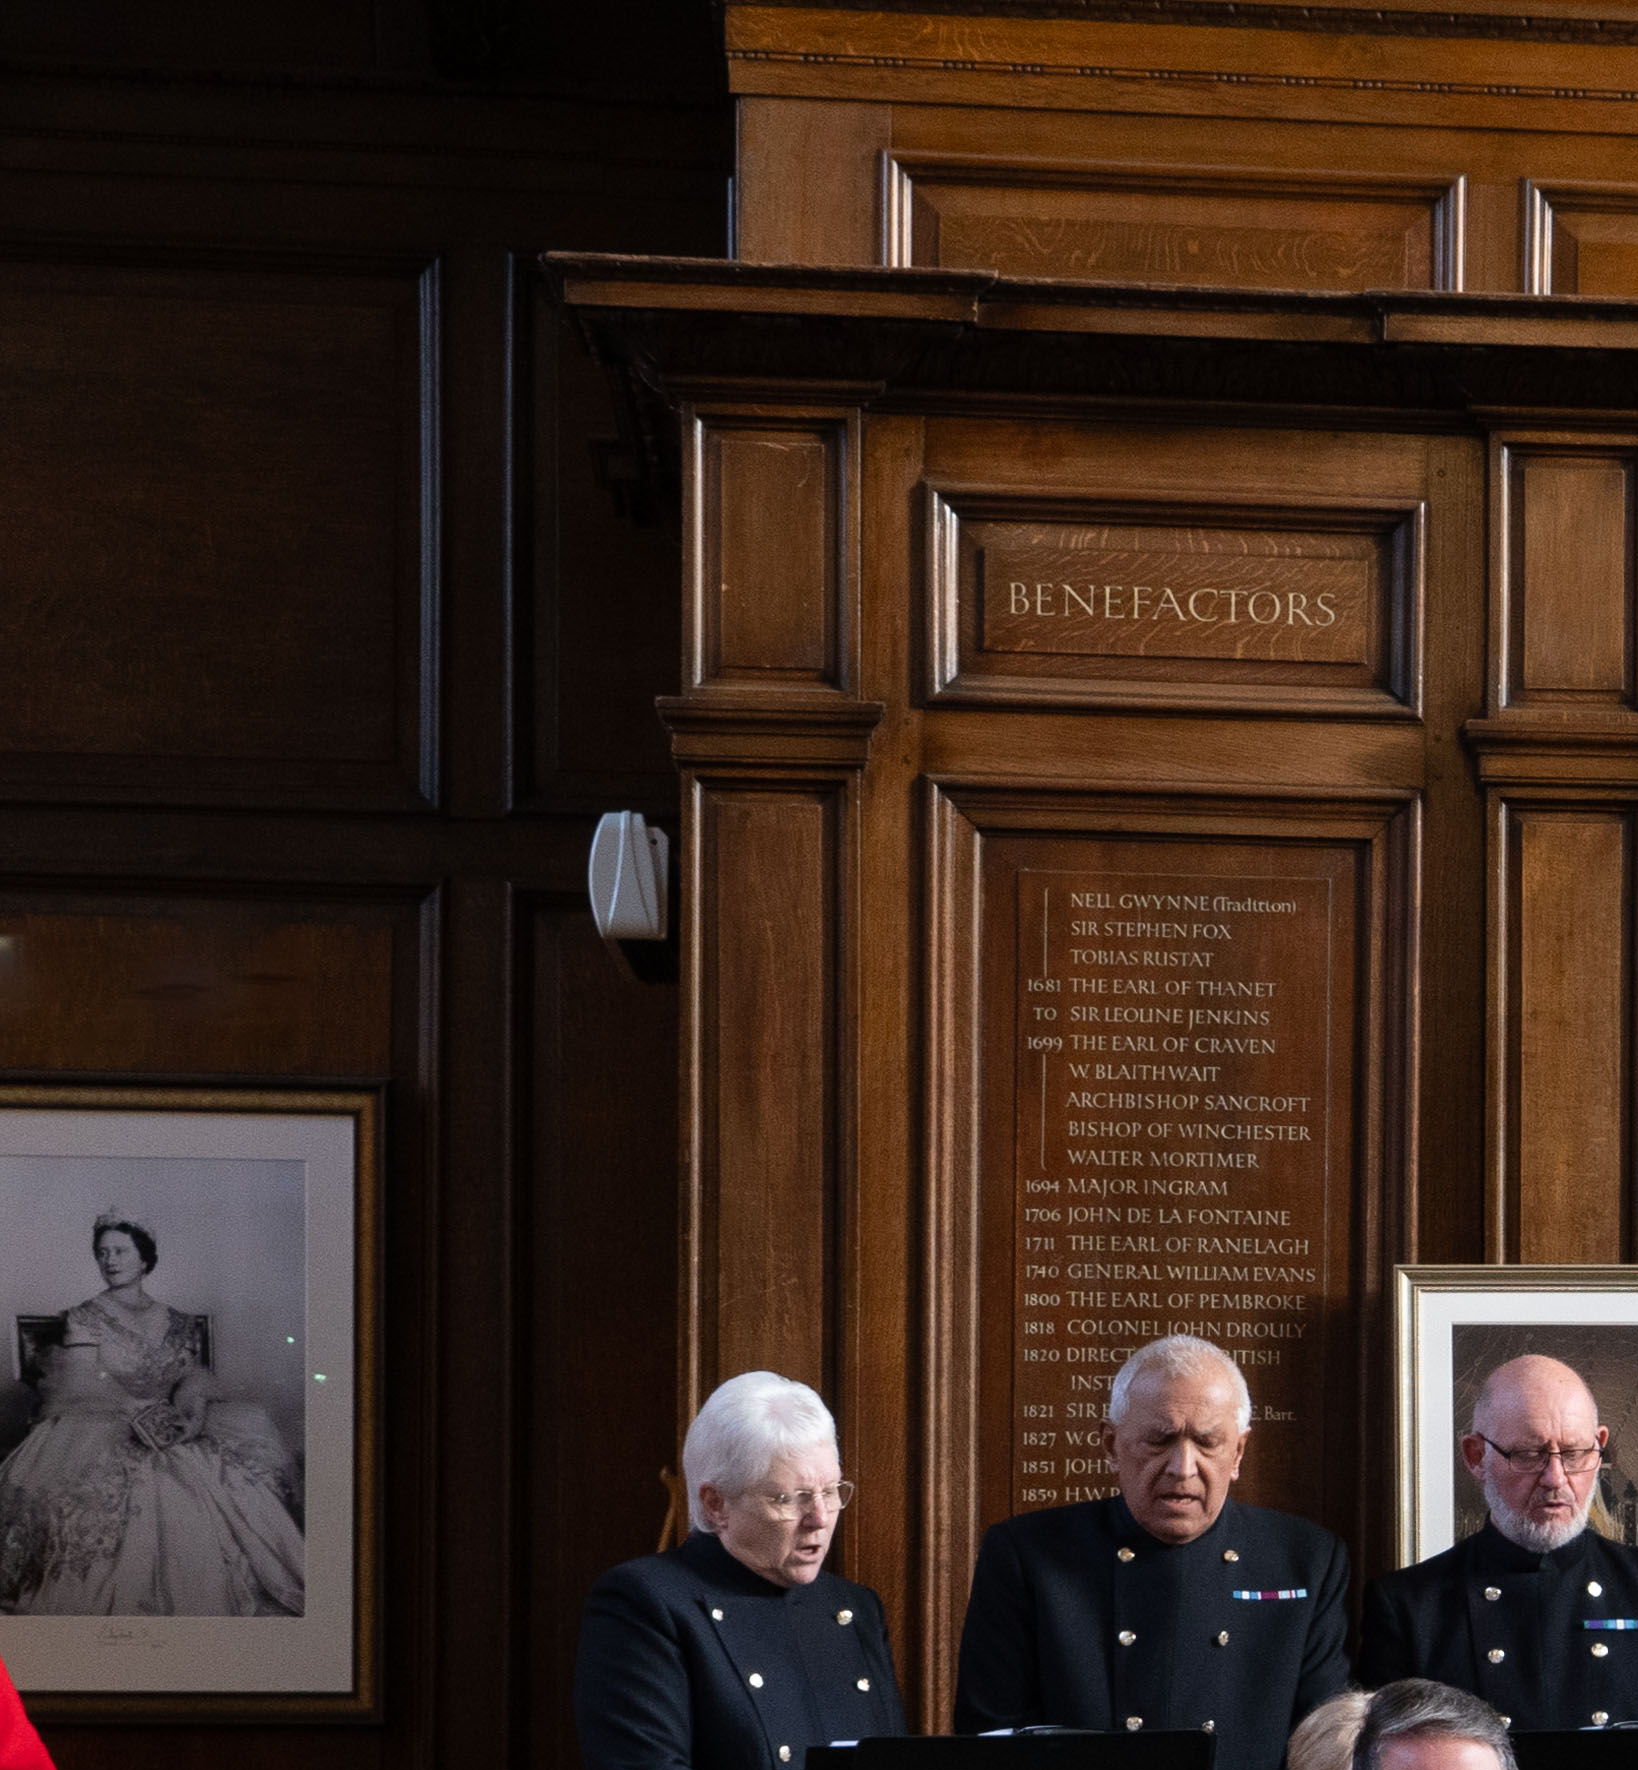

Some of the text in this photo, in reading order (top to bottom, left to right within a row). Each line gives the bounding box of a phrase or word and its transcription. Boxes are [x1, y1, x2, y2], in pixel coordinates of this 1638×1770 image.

[1009, 582, 1336, 626] BENEFACTORS
[1071, 893, 1296, 913] NELL GWYNNE (Tradition)
[1072, 921, 1231, 939] SIR STEPHEN FOX
[1070, 949, 1213, 966] TOBIAS RUSTAT
[1028, 978, 1275, 997] 1681 THE EARL OF THANET
[1034, 1006, 1269, 1030] TO SIR LEOLINE JENKINS
[1028, 1035, 1275, 1053] 1699 THE EARL OF CRAVEN
[1096, 1064, 1220, 1081] BLAITHWAIT
[1066, 1092, 1310, 1112] ARCHBISHOP SANCROFT
[1069, 1121, 1311, 1140] BISHOP OF WINCHESTER
[1068, 1150, 1259, 1168] WALTER MORTIMER
[1026, 1178, 1228, 1197] 1694 MAJOR INGRAM
[1026, 1207, 1290, 1226] 1706 JOHN DE LA FONTAINE
[1026, 1236, 1309, 1255] 1711 THE EARL OF RANELAGH
